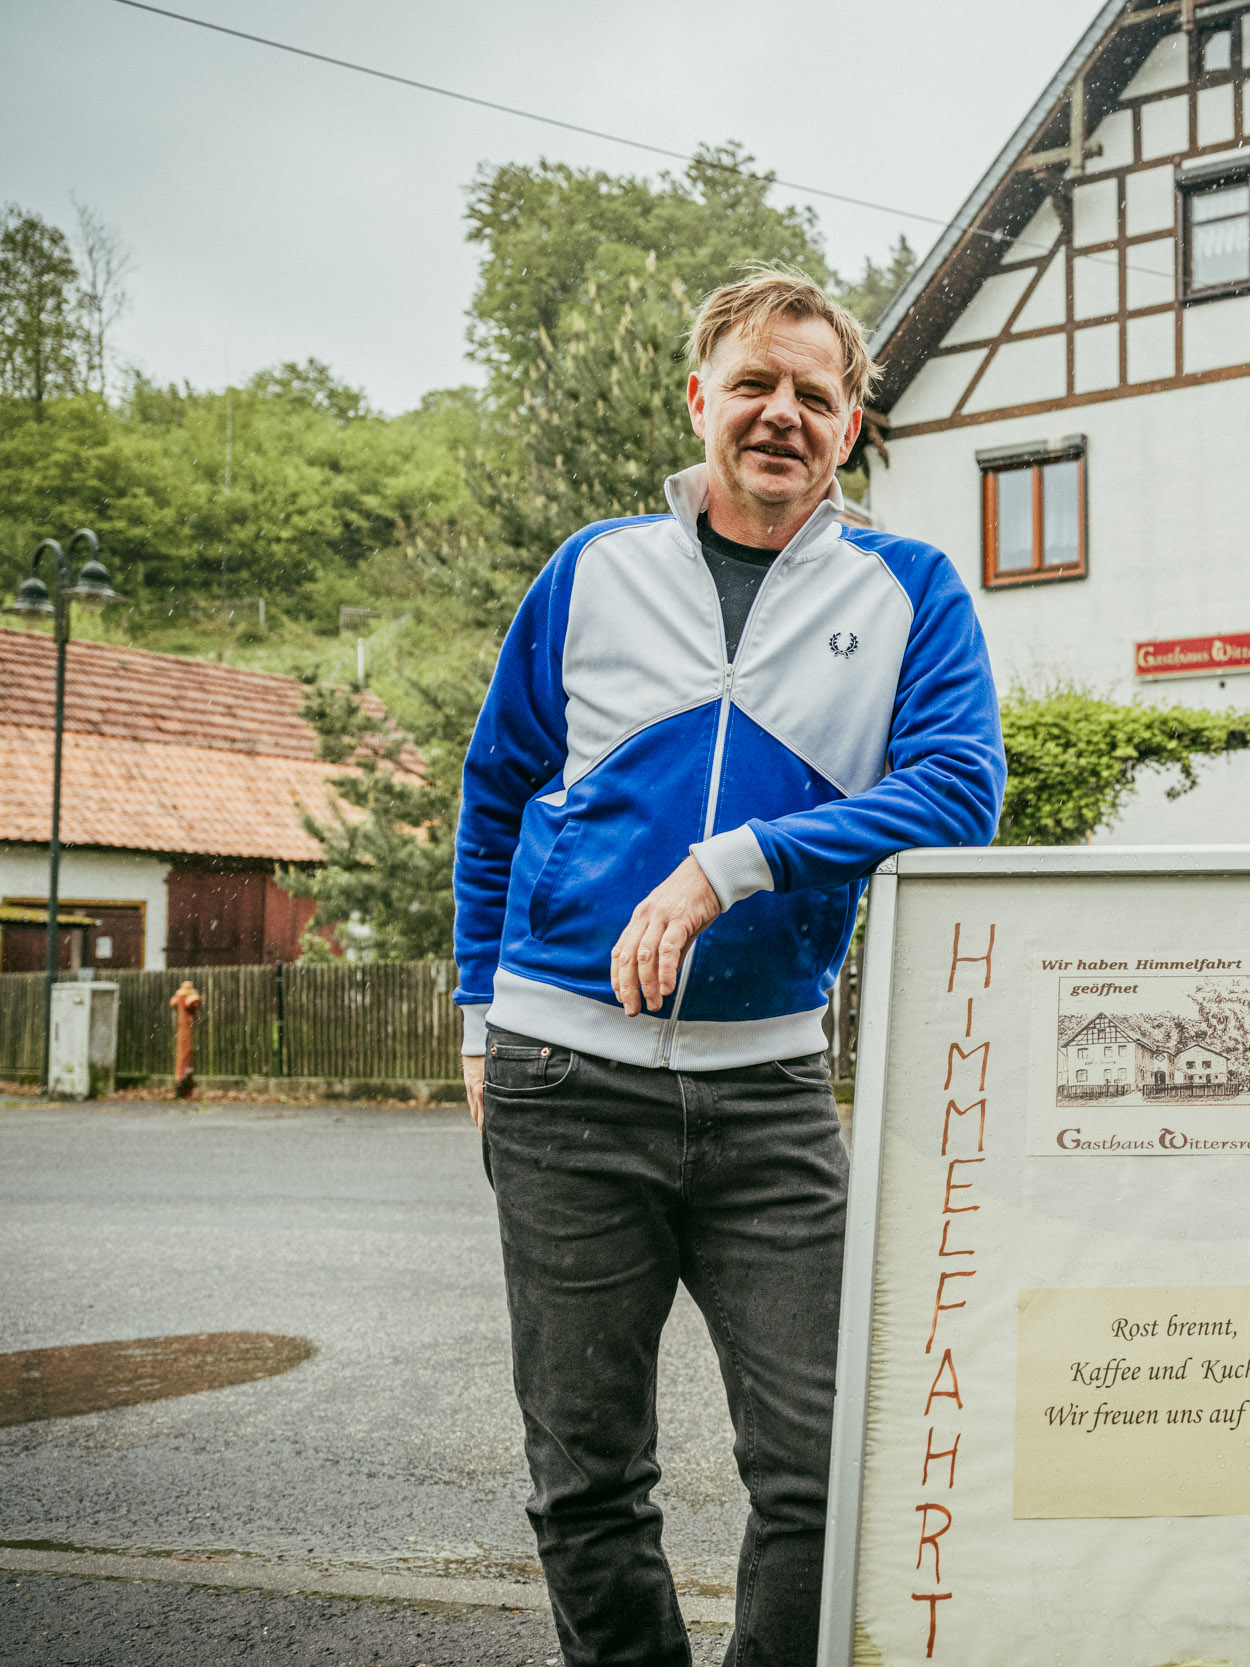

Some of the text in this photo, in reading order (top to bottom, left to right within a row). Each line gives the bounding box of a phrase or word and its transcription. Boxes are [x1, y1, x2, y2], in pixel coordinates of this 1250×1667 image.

[1137, 644, 1210, 668] Gasthaus
[1041, 958, 1242, 973] Wir haben Himmelfahrt
[1070, 982, 1139, 997] geöffnet
[1056, 1127, 1154, 1152] Gasthaus
[911, 922, 995, 1660] HIMMELFAHRT
[1111, 1314, 1238, 1342] Rost brennt,
[1070, 1358, 1141, 1389] Kaffee
[1148, 1357, 1193, 1381] und
[1044, 1403, 1089, 1427] Wir
[1086, 1402, 1160, 1433] freuen
[1167, 1409, 1203, 1425] uns
[1209, 1399, 1250, 1431] auf
